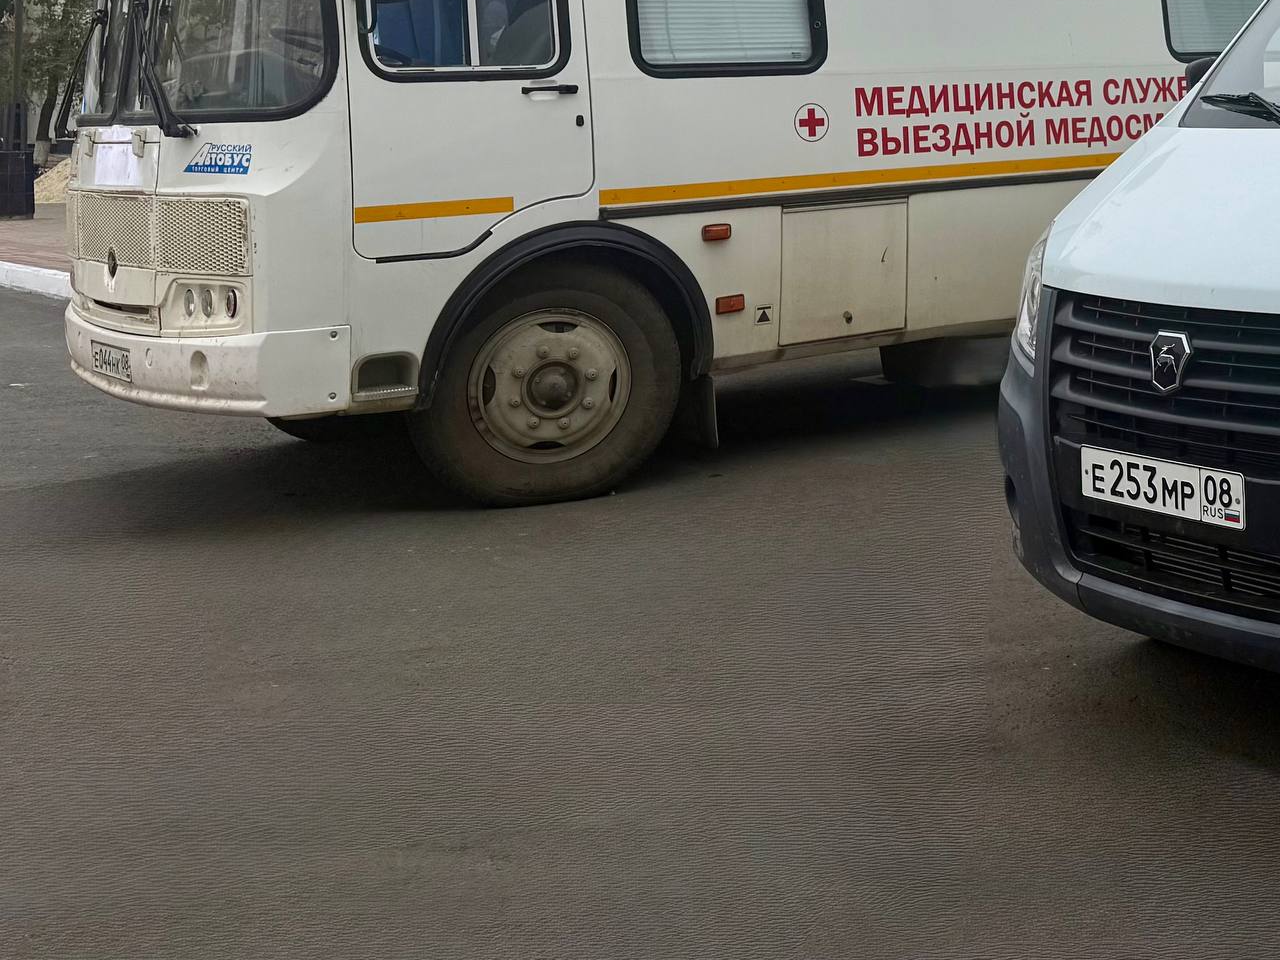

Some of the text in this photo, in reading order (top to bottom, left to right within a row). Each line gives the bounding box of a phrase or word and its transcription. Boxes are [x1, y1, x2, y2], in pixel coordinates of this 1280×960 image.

[855, 80, 1092, 117] МЕДИЦИНСКАЯ
[856, 114, 1035, 158] ВЫЕЗДНОЙ
[210, 143, 252, 153] РУССКИЙ
[223, 166, 244, 174] ЦЕНТР
[1203, 506, 1223, 519] RUS
